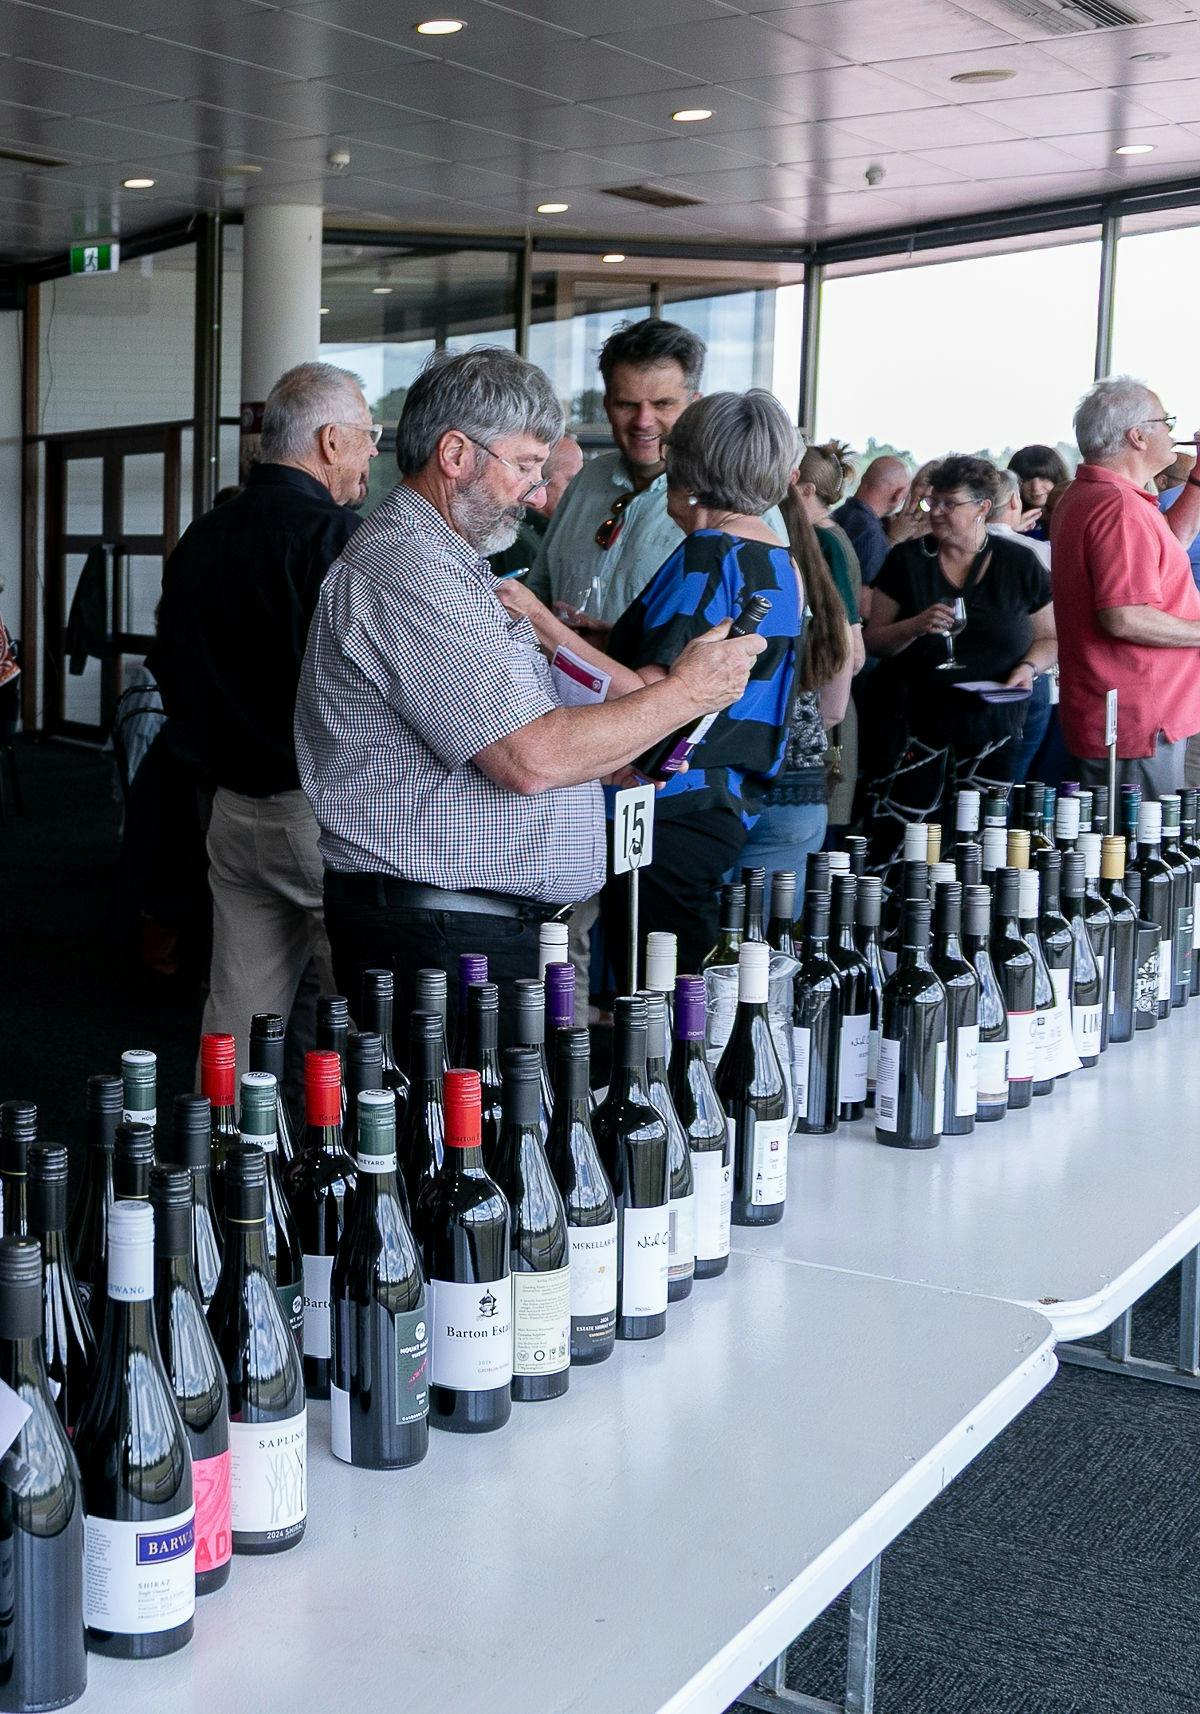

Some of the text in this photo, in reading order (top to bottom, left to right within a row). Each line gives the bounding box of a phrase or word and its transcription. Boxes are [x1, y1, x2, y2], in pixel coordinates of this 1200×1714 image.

[622, 800, 646, 859] 15
[447, 1325, 488, 1339] Barton
[266, 1530, 284, 1540] 2024
